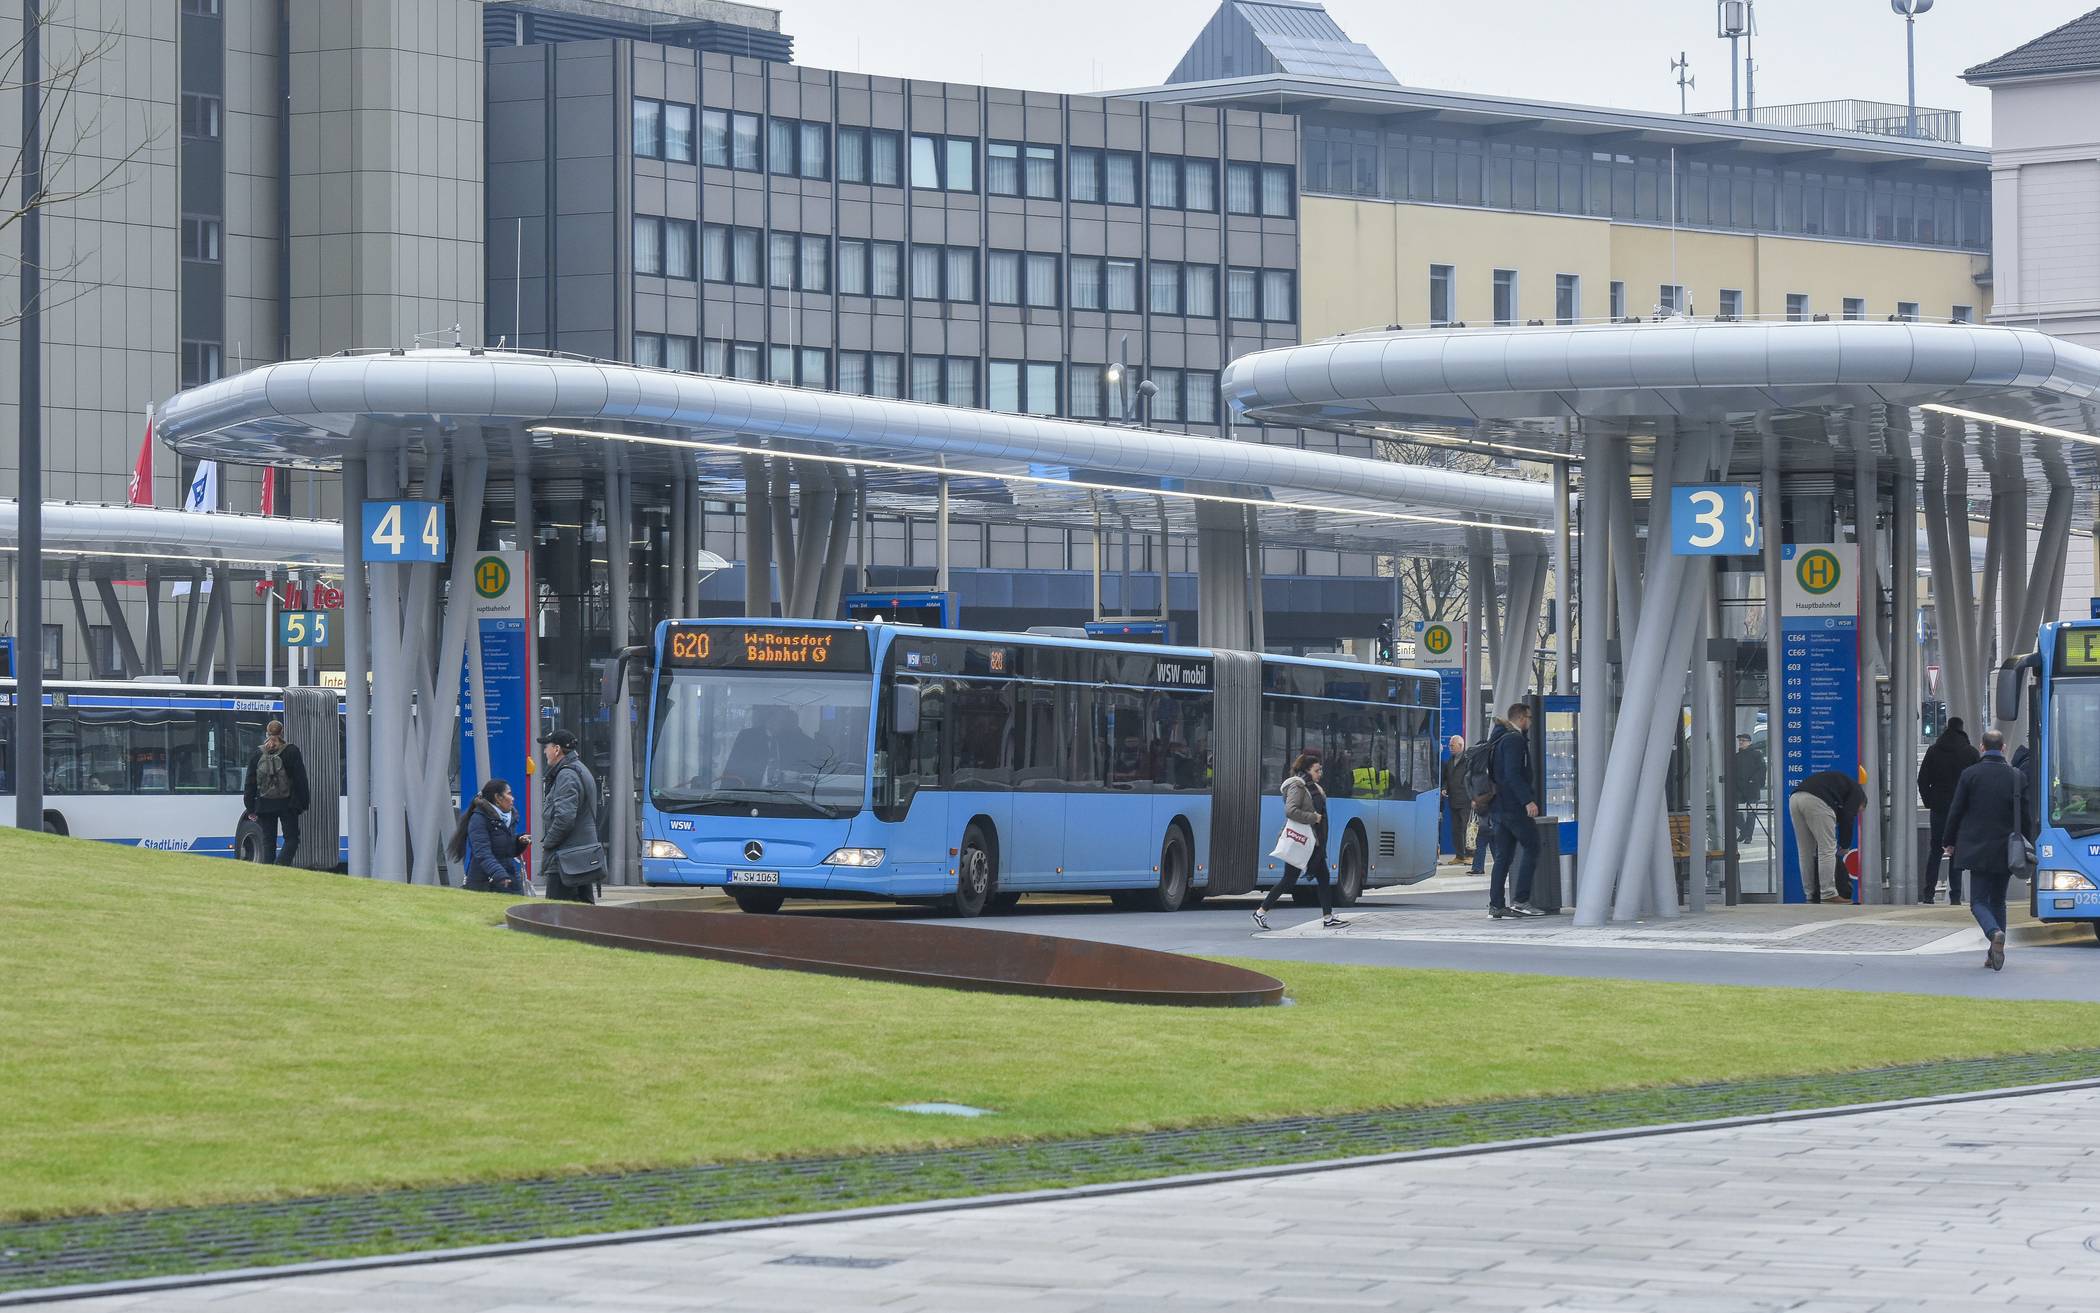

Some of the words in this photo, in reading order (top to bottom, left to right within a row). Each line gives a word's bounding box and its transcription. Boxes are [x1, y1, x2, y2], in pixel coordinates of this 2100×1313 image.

[1688, 490, 1725, 548] 3
[1744, 490, 1755, 547] 3
[371, 505, 405, 555] 4
[422, 506, 439, 556] 4
[1785, 548, 1791, 556] 3
[483, 566, 499, 589] H
[1809, 560, 1827, 584] H
[1795, 602, 1841, 610] Hauptbahnhof
[287, 614, 306, 643] 5
[315, 614, 325, 643] 5
[673, 633, 709, 658] 620
[744, 634, 832, 646] W-Ronsdorf
[1432, 632, 1444, 648] H
[1787, 634, 1806, 642] CE64
[748, 646, 806, 662] Bahnhof
[1157, 663, 1180, 683] WSW
[1182, 664, 1206, 684] mobil
[236, 701, 270, 711] StadtLinie
[1788, 721, 1802, 729] 625
[1788, 750, 1802, 758] 645
[670, 821, 692, 830] WSW
[144, 839, 189, 850] StadtLinie
[757, 873, 777, 882] 1063
[2075, 893, 2100, 905] 026
